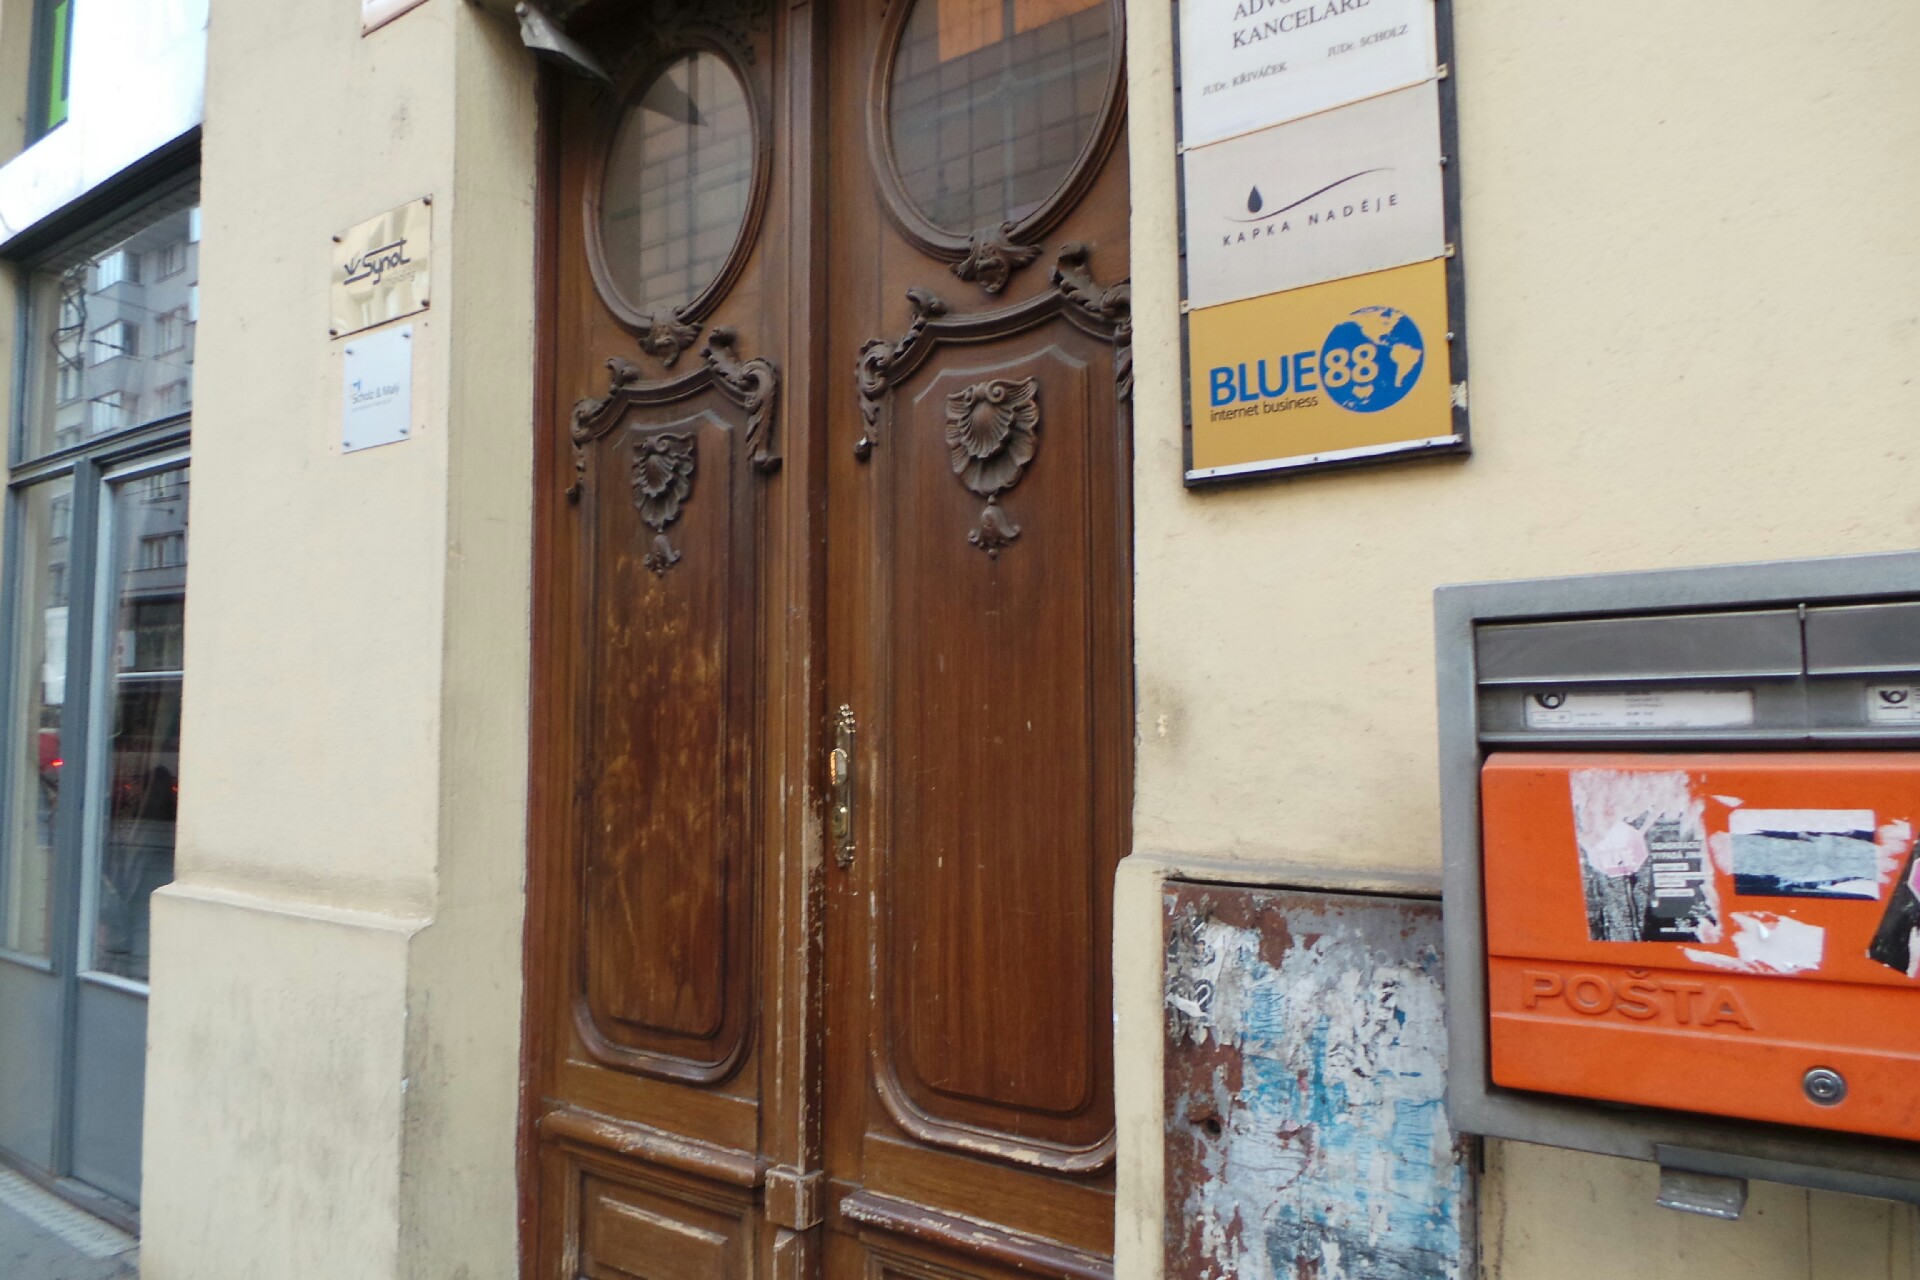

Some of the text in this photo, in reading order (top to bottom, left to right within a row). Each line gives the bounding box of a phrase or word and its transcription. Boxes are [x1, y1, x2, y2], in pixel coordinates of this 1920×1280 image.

[1359, 24, 1409, 48] SCHOLZ
[1222, 220, 1291, 247] KAPKA
[1209, 395, 1319, 423] internet business
[1522, 969, 1754, 1031] POŠTA
